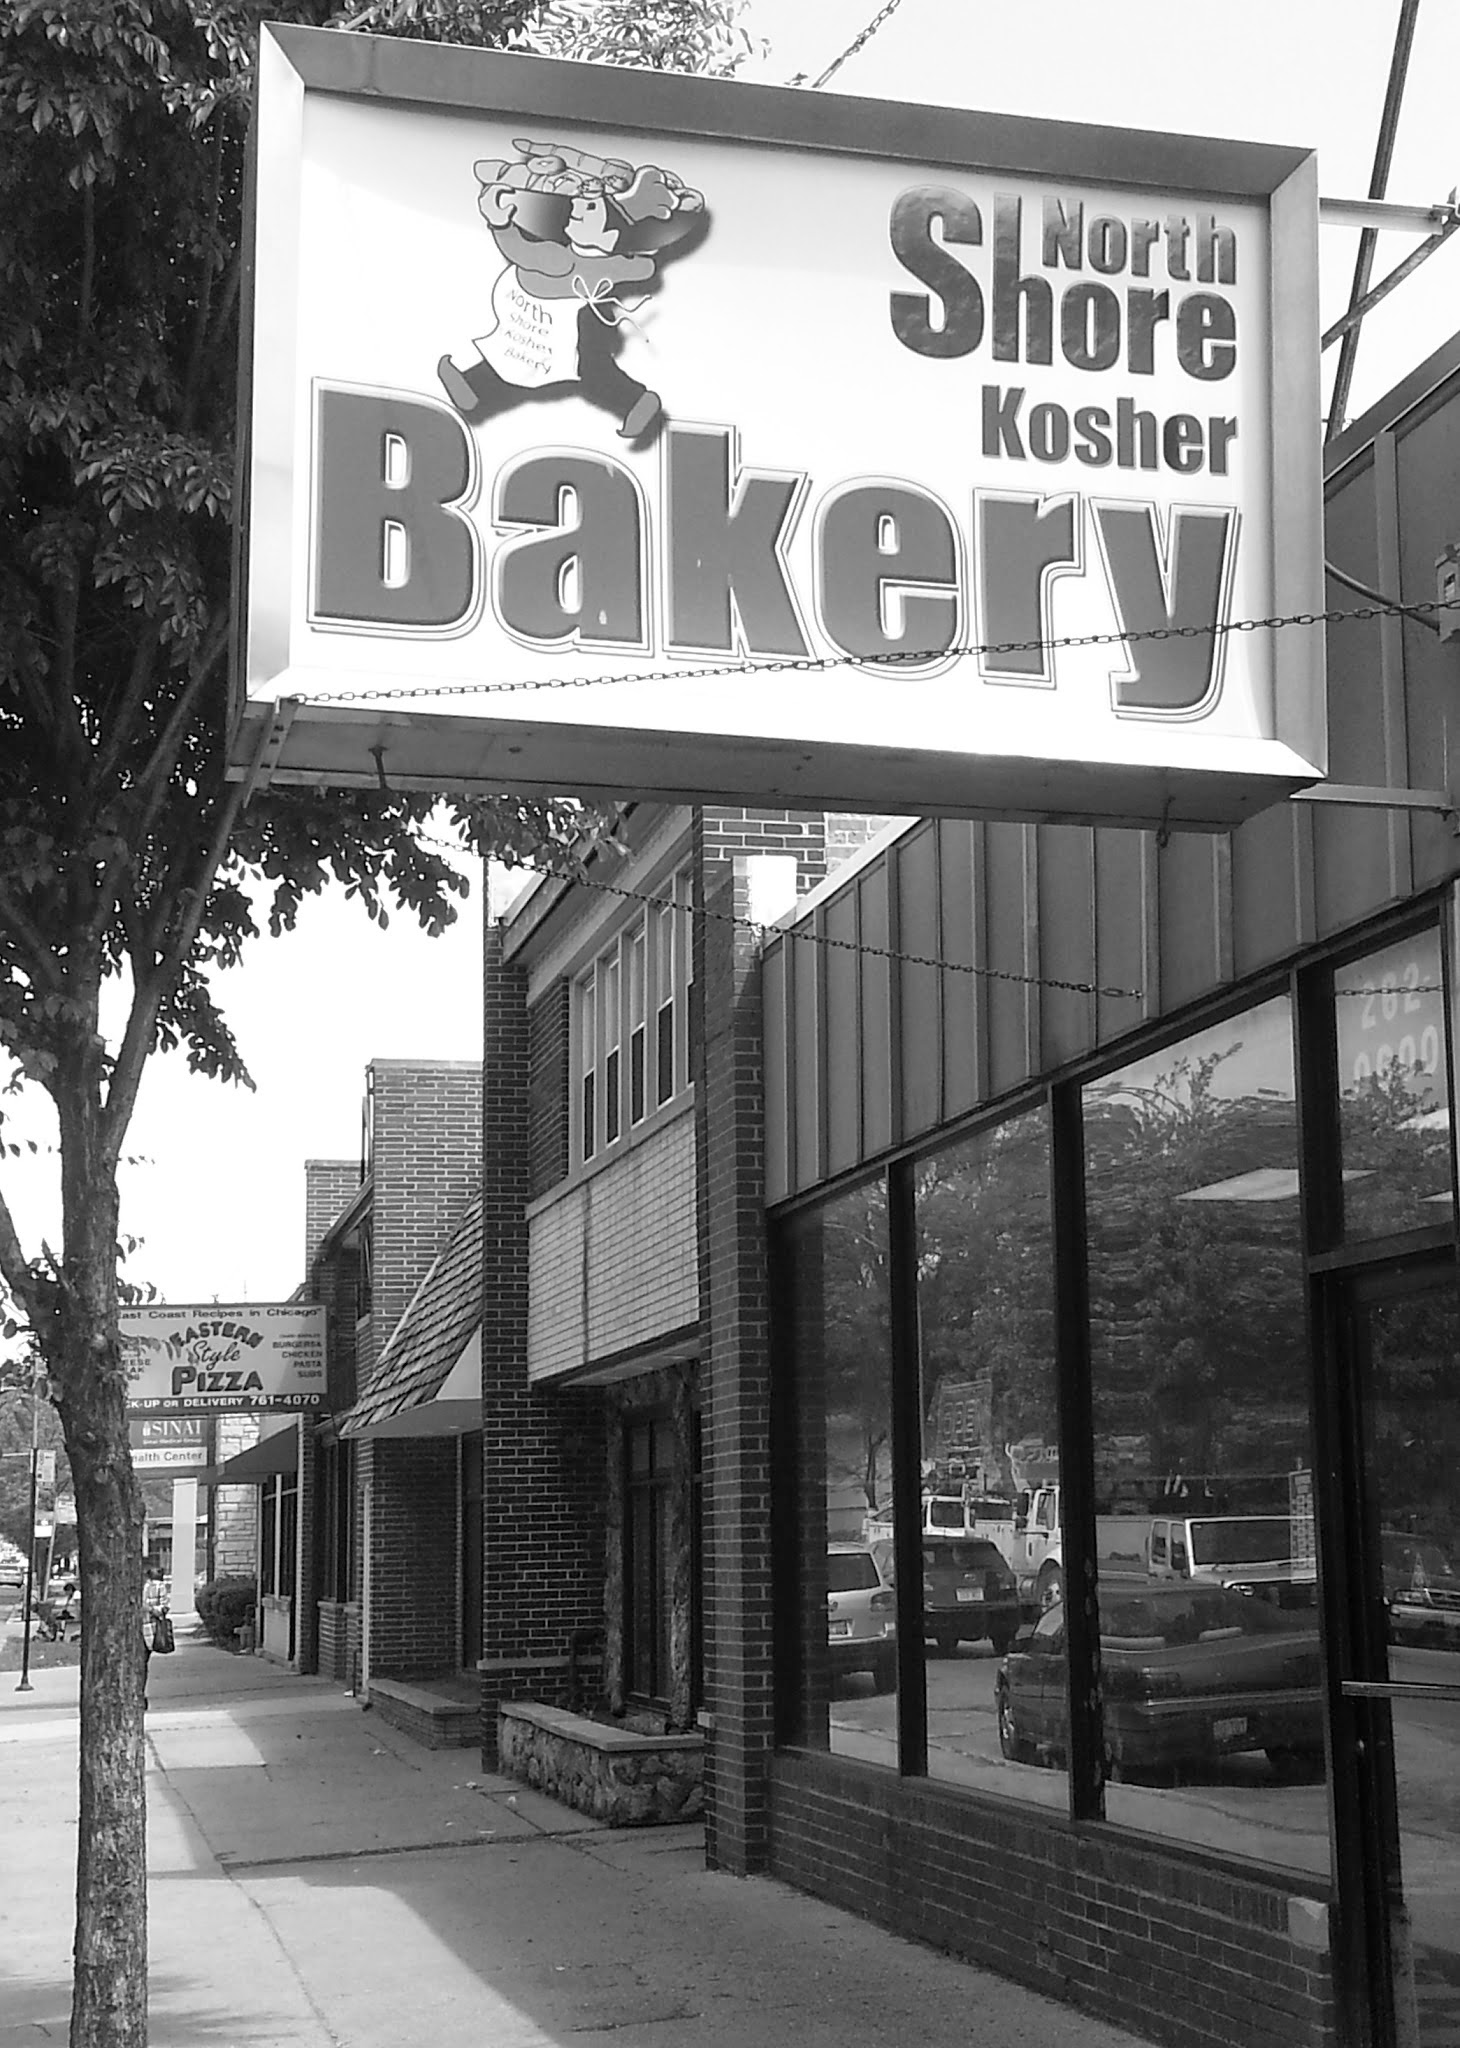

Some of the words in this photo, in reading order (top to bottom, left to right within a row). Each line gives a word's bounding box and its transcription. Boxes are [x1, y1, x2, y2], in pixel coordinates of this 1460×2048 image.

[1042, 195, 1236, 285] North
[889, 184, 1236, 381] Shore
[507, 288, 553, 325] North
[981, 385, 1237, 475] Kosher
[306, 376, 1242, 723] Bakery
[119, 1310, 142, 1320] ast
[149, 1310, 186, 1319] Coast
[193, 1309, 243, 1320] Recipes
[250, 1308, 260, 1317] in
[169, 1321, 264, 1349] EASTERN
[193, 1340, 240, 1371] Style
[282, 1351, 322, 1359] CHICKEN
[294, 1360, 322, 1368] PASTA
[172, 1366, 263, 1396] PIZZA
[184, 1397, 244, 1408] DELIVERY
[249, 1394, 320, 1406] 761-4070
[152, 1419, 201, 1436] SINAI
[132, 1453, 160, 1463] alth
[164, 1451, 202, 1462] Center
